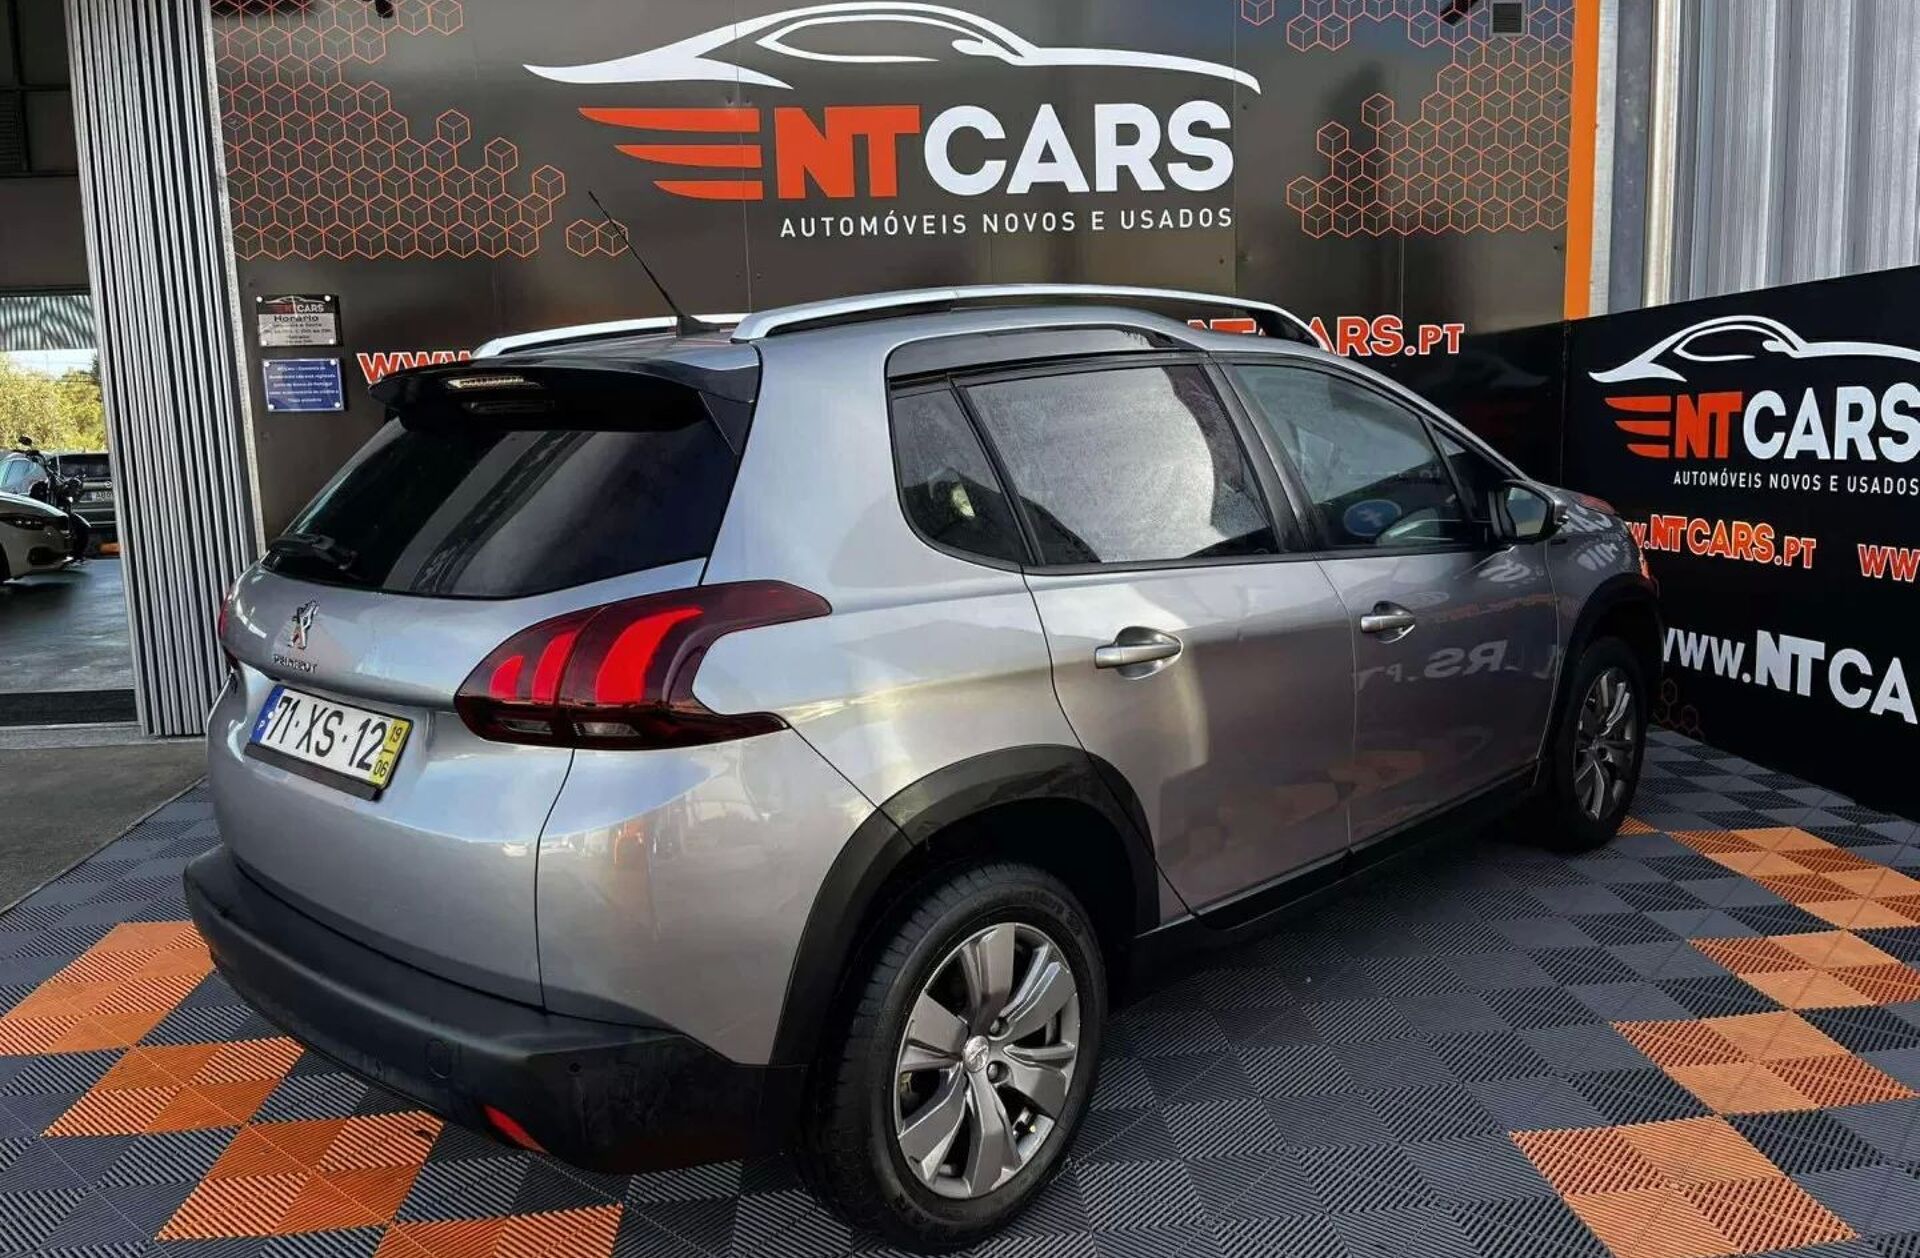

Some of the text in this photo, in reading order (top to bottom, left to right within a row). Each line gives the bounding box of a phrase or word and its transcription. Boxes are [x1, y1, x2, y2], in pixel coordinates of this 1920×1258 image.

[774, 101, 1234, 199] NTCARS
[780, 208, 1232, 237] AUTOMÓVEIS NOVOS E USADOS
[1675, 382, 1920, 463] NTCARS
[1673, 467, 1919, 496] AUTOMÓVEIS NOVOS E USADOS
